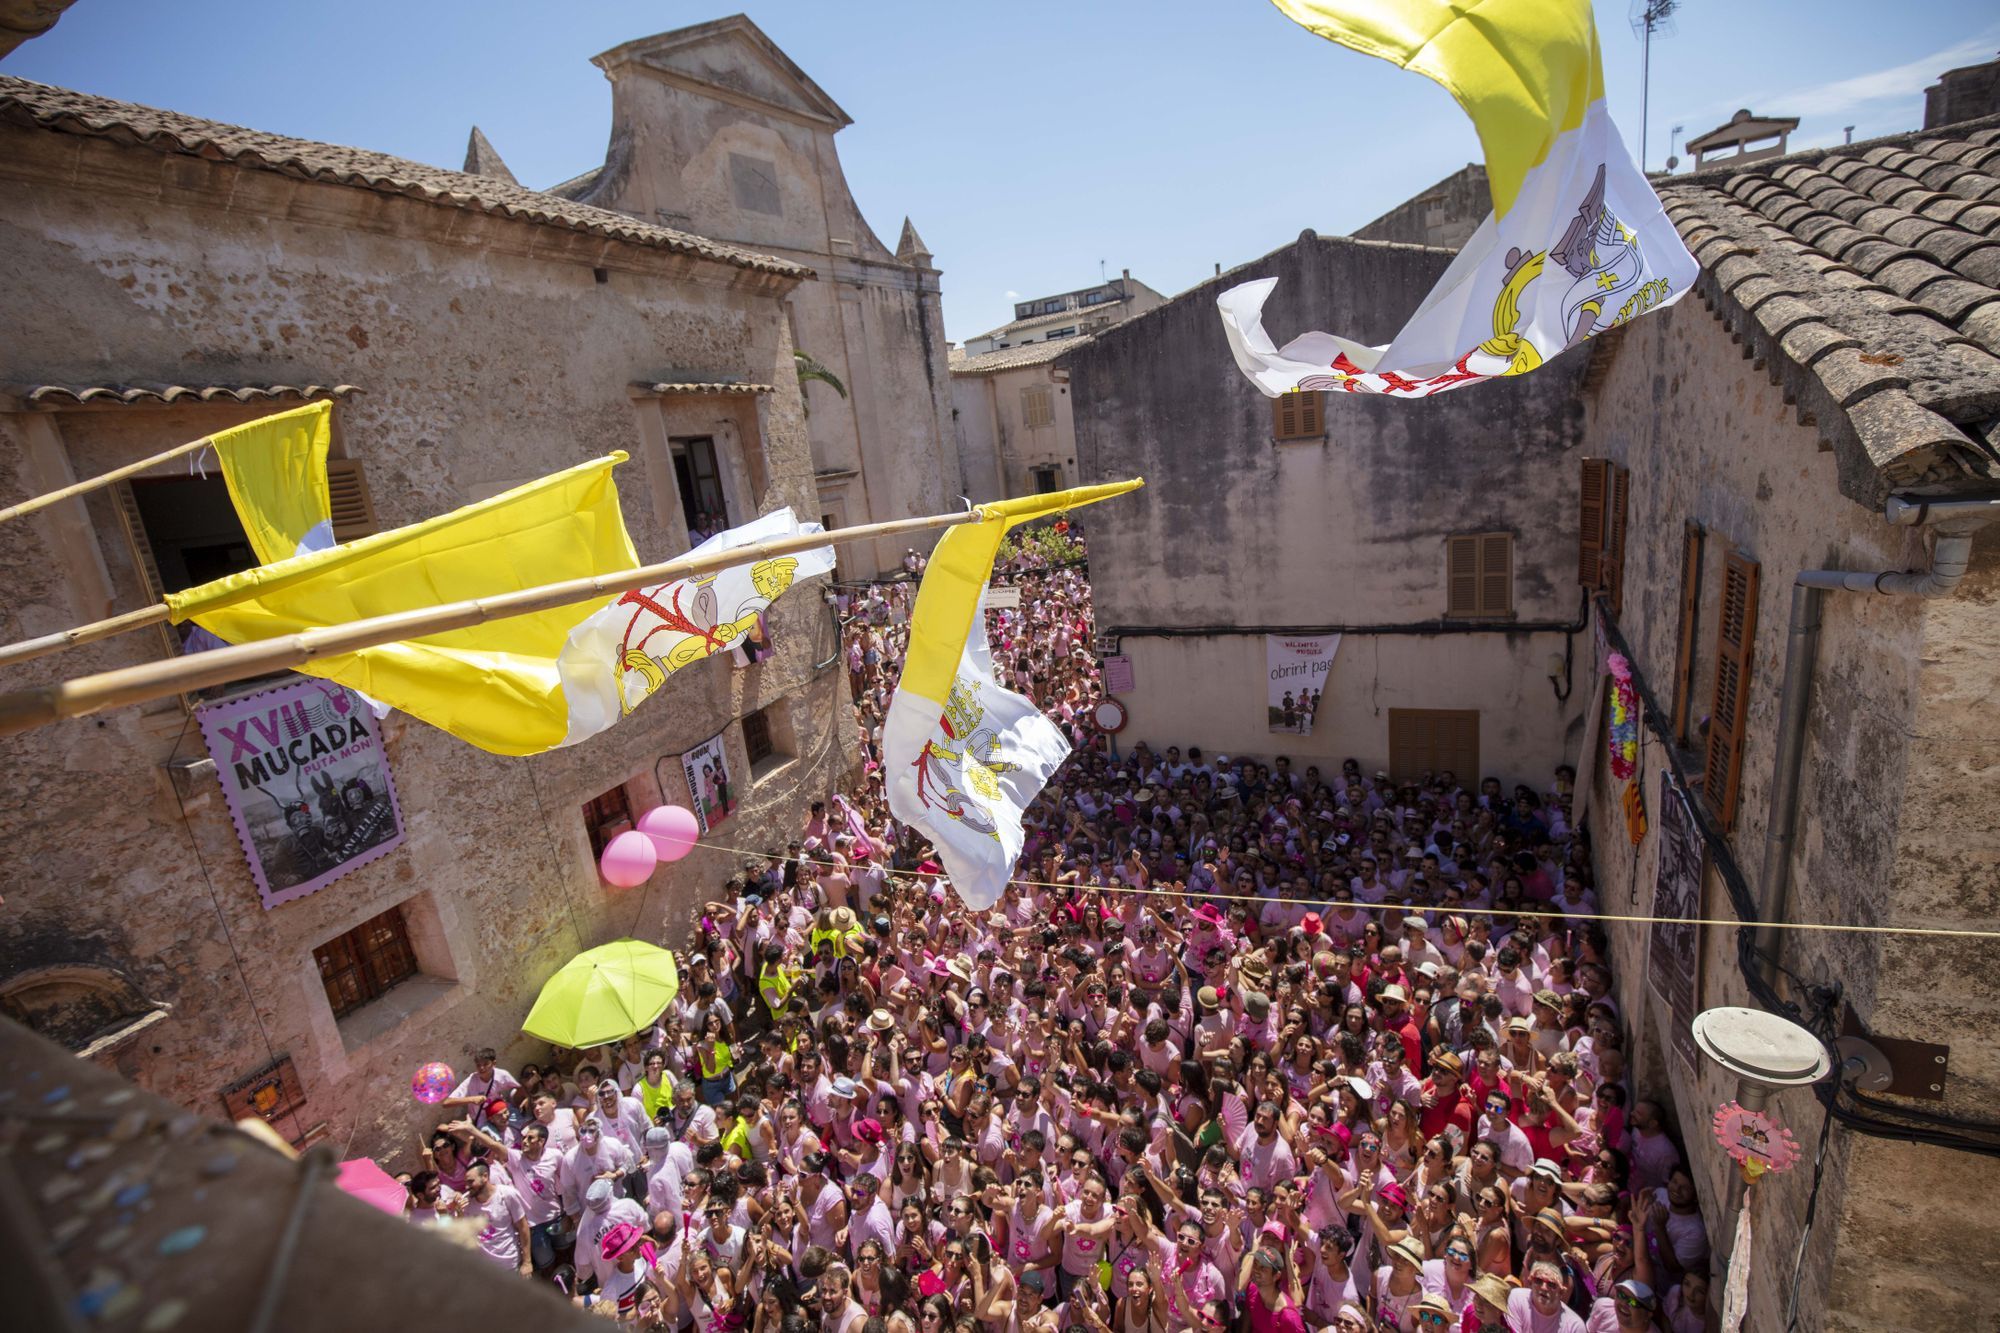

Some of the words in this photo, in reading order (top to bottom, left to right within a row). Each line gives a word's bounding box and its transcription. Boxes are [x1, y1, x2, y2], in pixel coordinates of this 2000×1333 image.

[1270, 661, 1307, 680] obrint
[217, 699, 312, 763] XVII
[234, 717, 370, 790] MUCADA
[303, 754, 338, 775] PUTA
